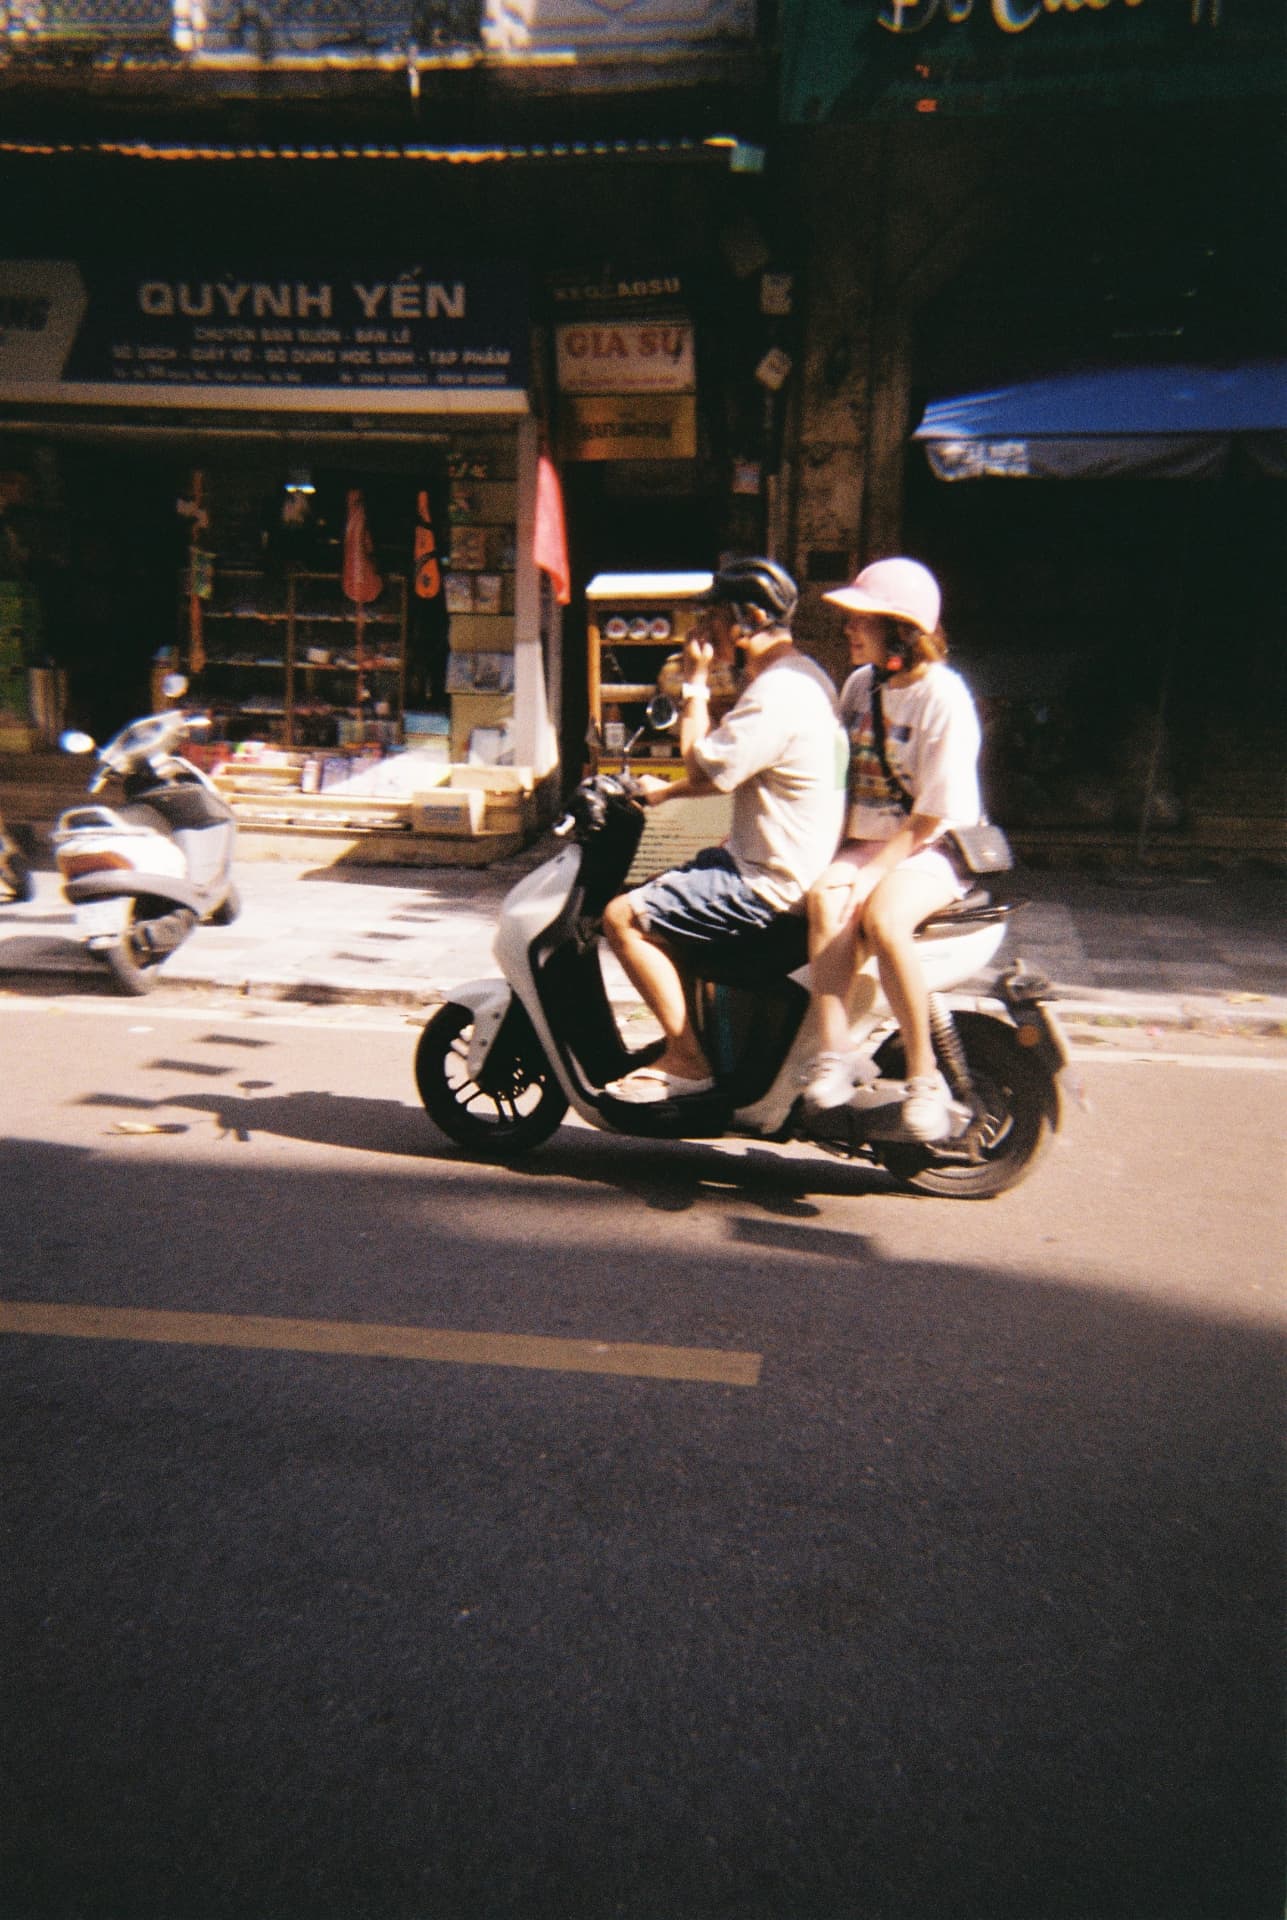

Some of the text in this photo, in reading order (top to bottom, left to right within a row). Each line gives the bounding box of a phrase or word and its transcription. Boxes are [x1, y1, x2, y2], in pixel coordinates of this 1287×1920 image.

[138, 265, 467, 318] QUỲNH YẾN
[564, 330, 629, 360] GIA
